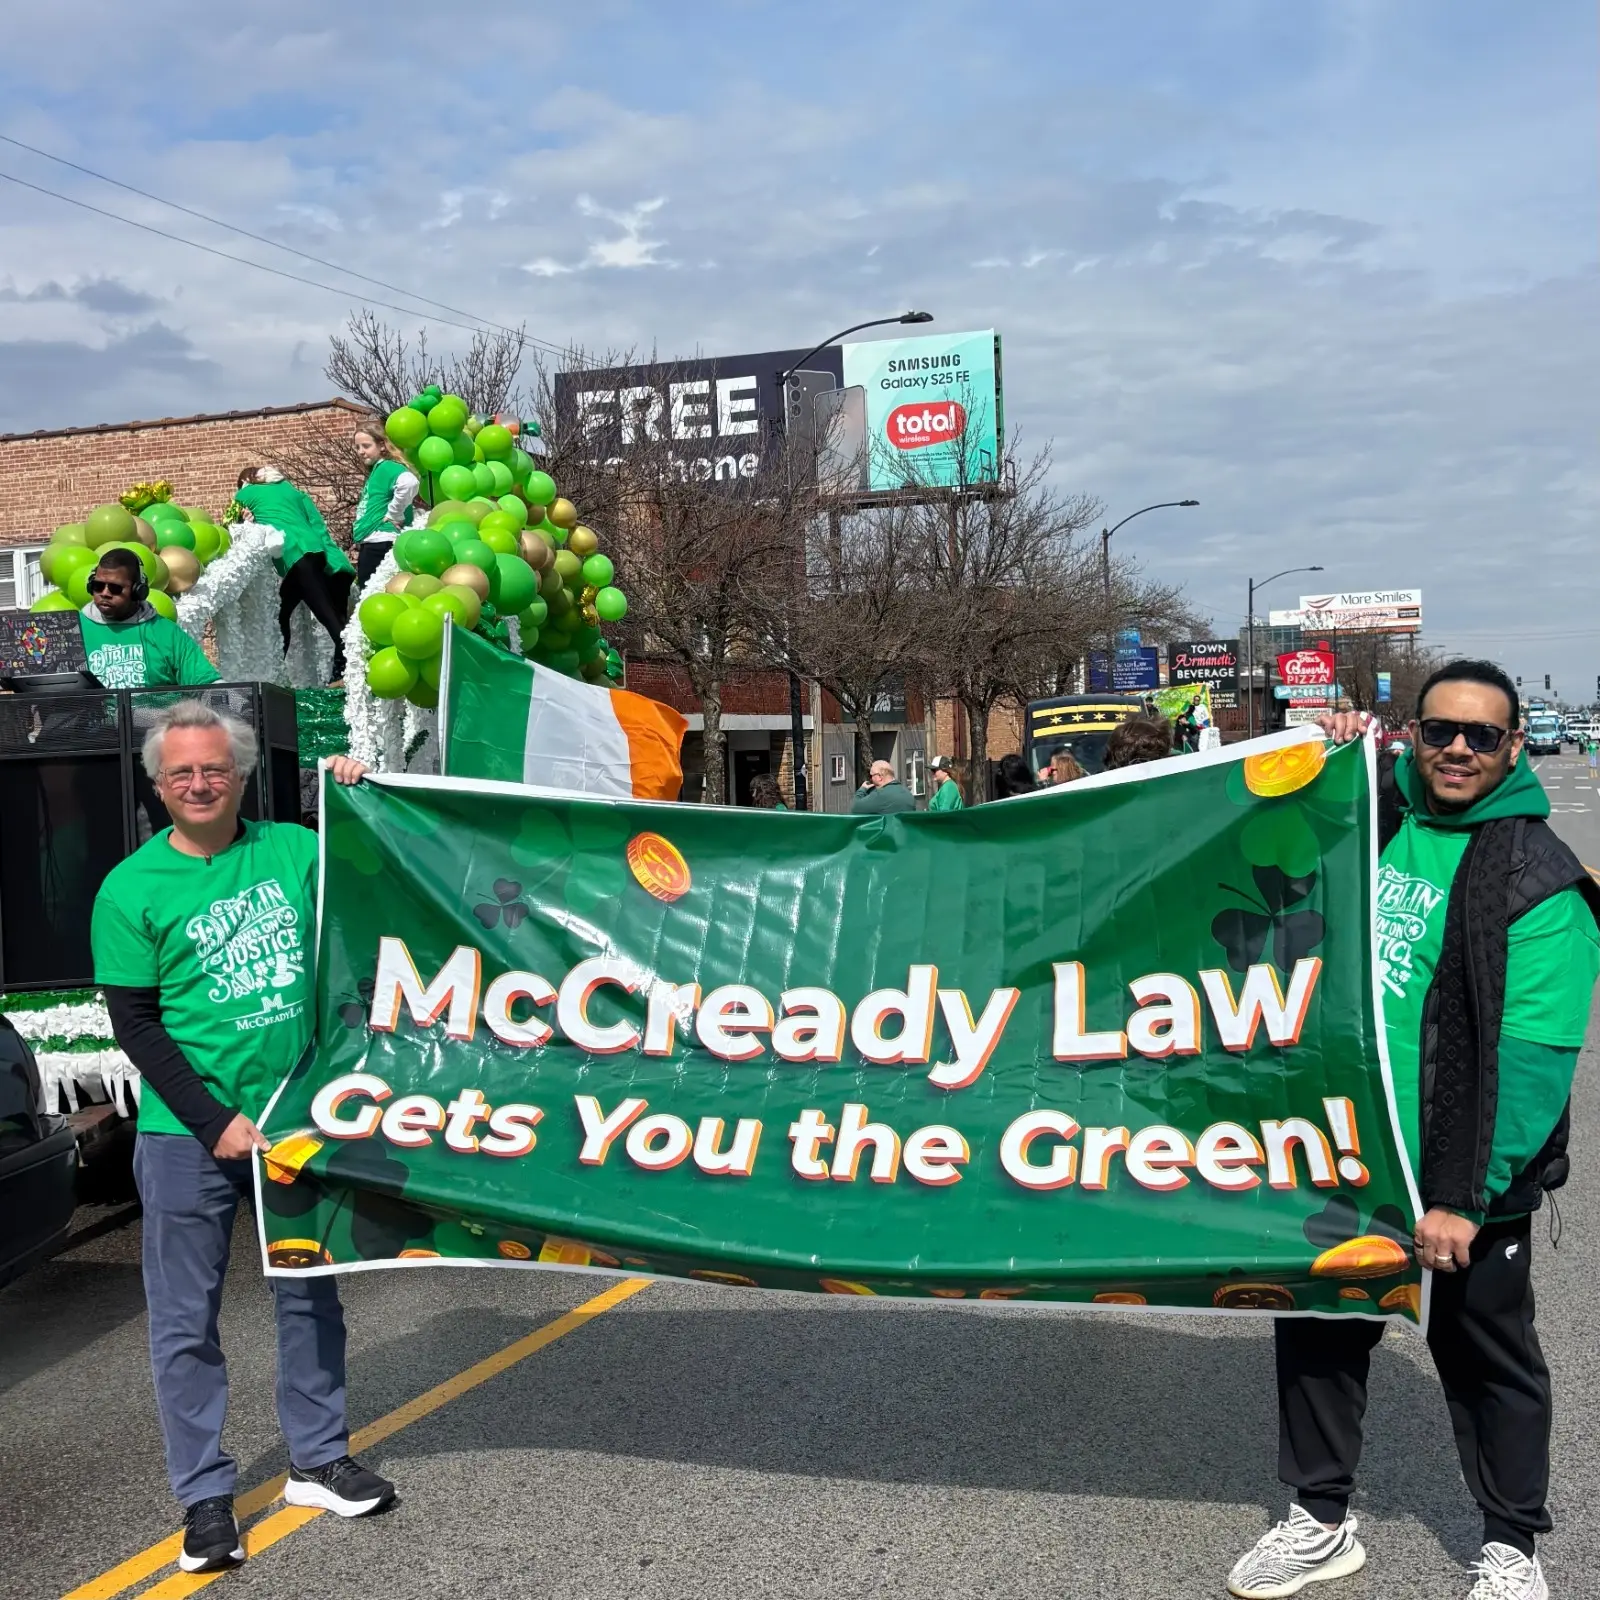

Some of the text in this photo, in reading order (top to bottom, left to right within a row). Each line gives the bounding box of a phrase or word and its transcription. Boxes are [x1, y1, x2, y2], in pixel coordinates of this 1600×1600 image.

[888, 353, 961, 373] SAMSUNG
[880, 370, 970, 390] Galaxy S25 FE
[576, 375, 759, 446] FREE
[896, 404, 956, 435] total
[898, 434, 930, 444] wireless
[1340, 591, 1413, 606] More Smiles
[1191, 643, 1227, 654] TOWN
[88, 646, 144, 675] DUBLIN
[1171, 652, 1237, 670] Armanetti
[1285, 658, 1330, 677] Beverly
[103, 671, 146, 687] JUSTICE
[1176, 667, 1235, 679] BEVERAGE
[1286, 675, 1328, 685] PIZZA
[186, 882, 290, 959] DUBLIN
[1388, 921, 1405, 939] ON
[225, 919, 280, 951] DOWN ON
[222, 927, 301, 973] JUSTICE
[369, 936, 1322, 1089] McCready Law
[310, 1072, 1370, 1191] Gets You the Green!
